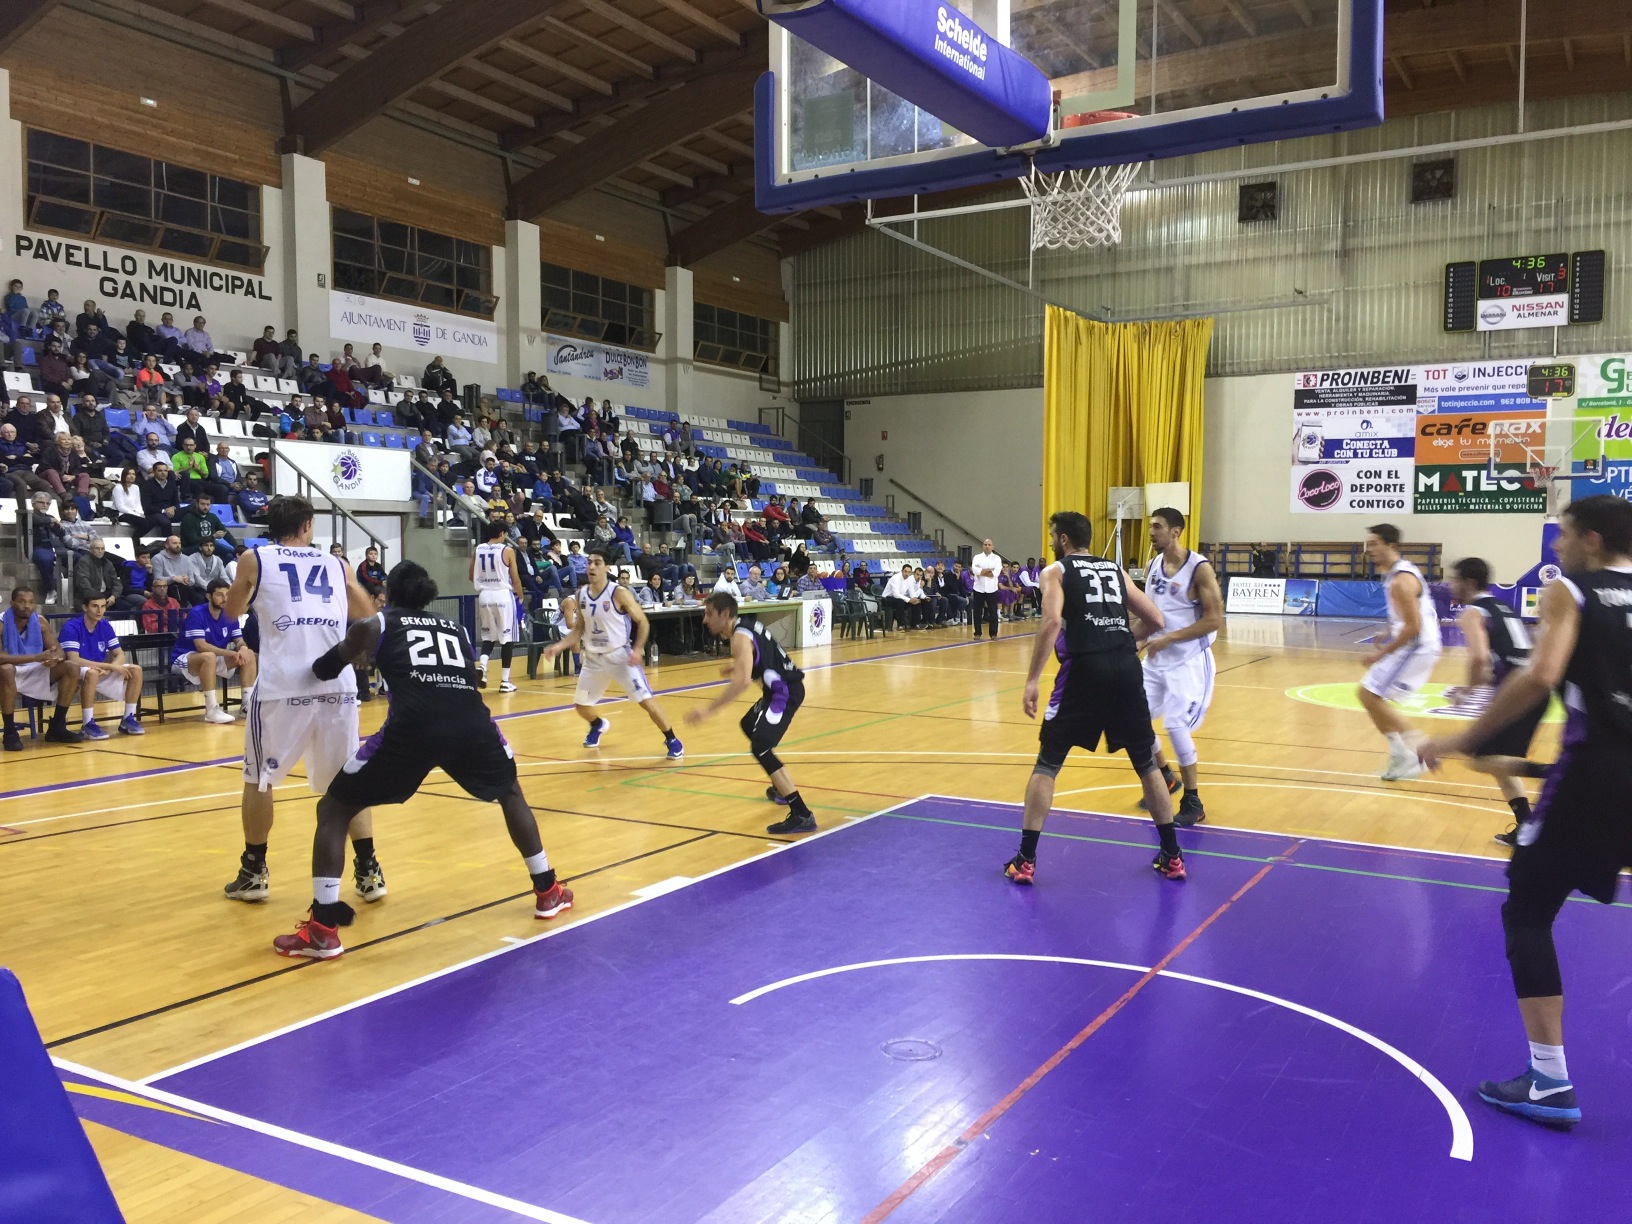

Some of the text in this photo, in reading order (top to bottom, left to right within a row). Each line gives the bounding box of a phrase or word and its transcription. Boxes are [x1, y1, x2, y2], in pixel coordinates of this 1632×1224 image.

[937, 6, 987, 61] Schelde
[935, 34, 986, 80] International
[15, 234, 272, 301] PAVELLO MUNICIPAL
[1512, 256, 1546, 269] 4:36
[1557, 267, 1567, 280] 3
[1496, 285, 1511, 298] 10
[1539, 281, 1554, 293] 17
[100, 276, 202, 312] GANDIA
[1511, 301, 1564, 312] NISSAN
[1516, 310, 1559, 319] ALMENAR
[340, 311, 488, 347] AJUNTAMENT DE GANDIA
[605, 352, 623, 364] DULCE
[1424, 363, 1530, 381] TOT INJECCI
[1541, 366, 1569, 377] 4:36
[1319, 369, 1411, 387] PROINBENI
[1458, 384, 1489, 393] prevenir
[1508, 382, 1526, 390] repa
[1544, 379, 1564, 393] 17
[1500, 398, 1514, 406] 962
[1296, 408, 1413, 418] www.proinbeni.com
[1432, 436, 1530, 448] elige tu mmeto
[1334, 448, 1398, 458] CON TU CLUB
[1356, 470, 1400, 479] CON EL
[332, 475, 363, 491] GANDIA
[1350, 483, 1405, 493] DEPORTE
[1349, 499, 1405, 509] CONTIGO
[479, 553, 496, 572] 11
[278, 562, 334, 604] 14
[1079, 568, 1123, 605] 33
[1232, 588, 1280, 598] BAYREN
[589, 603, 597, 617] 7
[296, 617, 339, 629] REPSOL
[400, 616, 437, 626] SEKOU
[406, 629, 466, 668] 20
[418, 673, 467, 685] València
